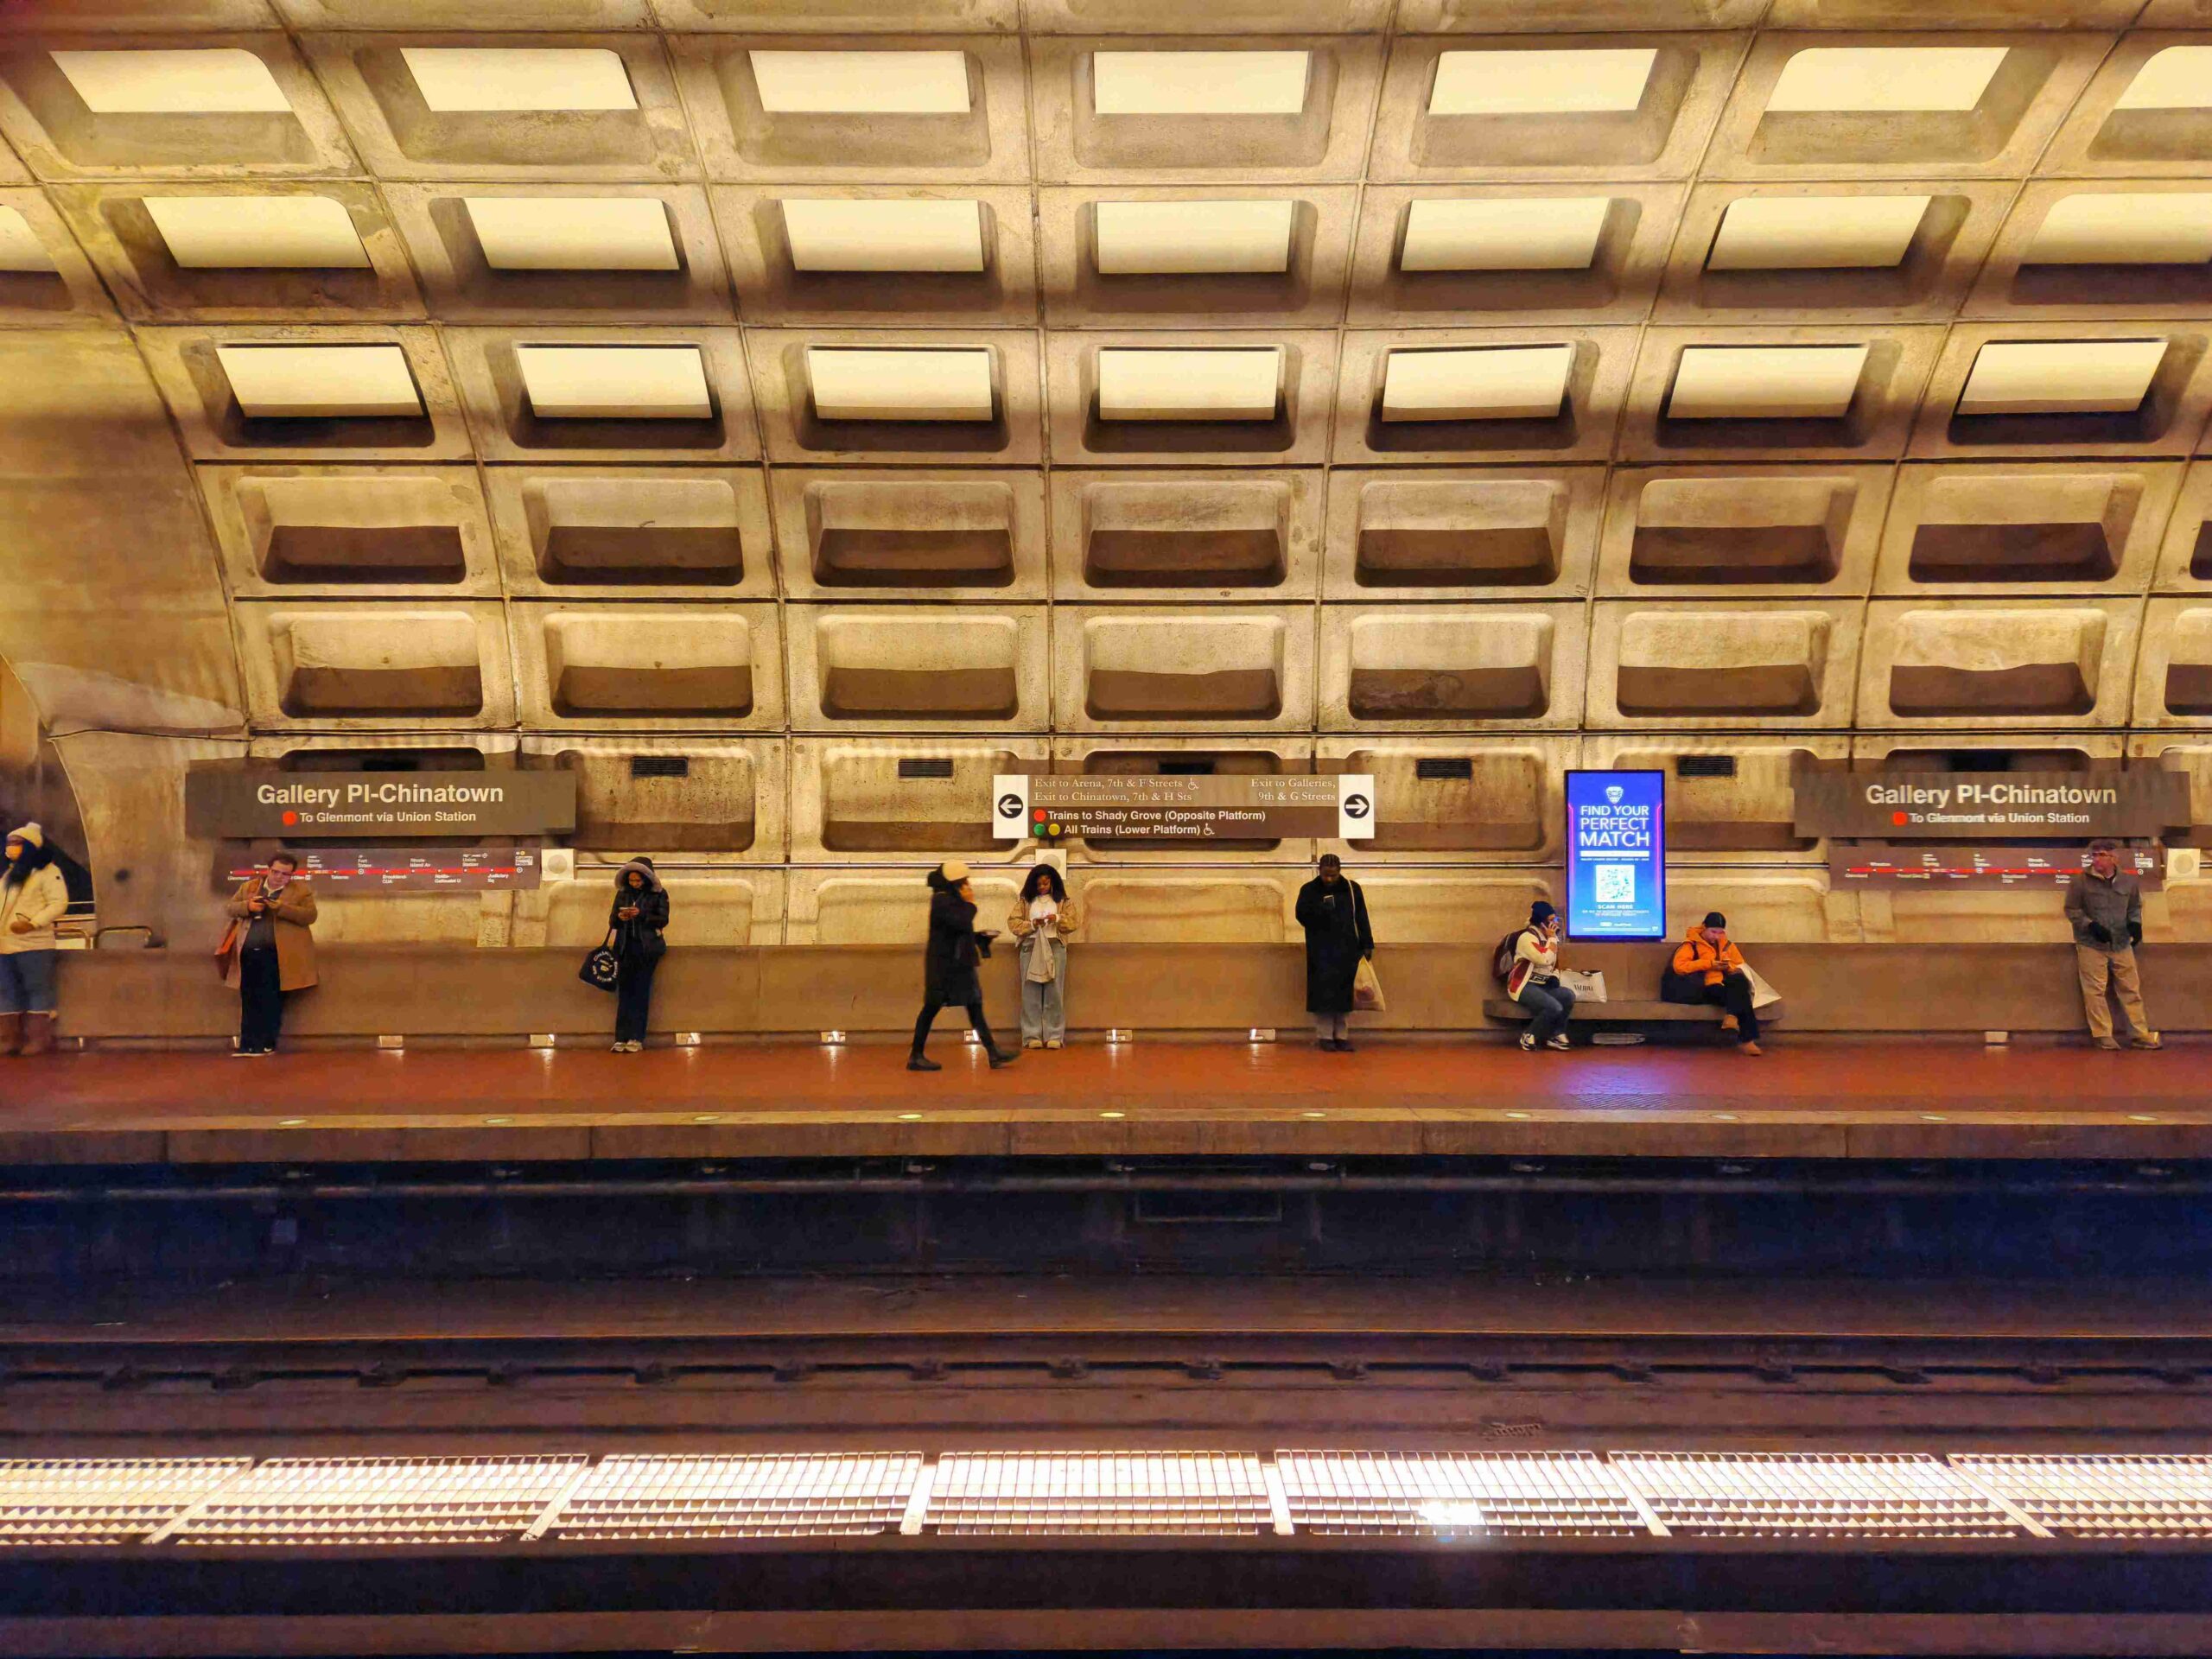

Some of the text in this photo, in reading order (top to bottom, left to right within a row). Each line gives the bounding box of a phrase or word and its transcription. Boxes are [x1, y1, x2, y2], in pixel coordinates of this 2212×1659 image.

[1035, 779, 1055, 787] Exit
[1071, 779, 1104, 789] Arena,
[1107, 779, 1122, 787] 7th
[1126, 779, 1135, 787] &
[1139, 779, 1146, 787] F
[1148, 779, 1183, 787] Streets
[1252, 779, 1272, 787] Exit
[1288, 779, 1336, 789] Galleries,
[257, 784, 340, 808] Gallery
[1034, 792, 1055, 801] Exit
[1071, 791, 1129, 803] Chinatown,
[1133, 791, 1148, 802] 7th
[1151, 791, 1160, 801] &
[1164, 792, 1173, 801] H
[1177, 791, 1192, 801] Sts
[1258, 791, 1335, 801] 9th & G Streets
[1866, 784, 1950, 809] Gallery
[1047, 810, 1266, 822] Trains to Shady Grove (Opposite Platform)
[1580, 805, 1649, 816] FIND YOUR
[299, 811, 476, 823] To Glenmont via Union Station
[1909, 812, 2089, 823] To Glenmont via Union Station
[1580, 817, 1649, 830] PERFECT
[1065, 824, 1200, 836] All Trains (Lower Platform)
[1580, 831, 1649, 847] MATCH
